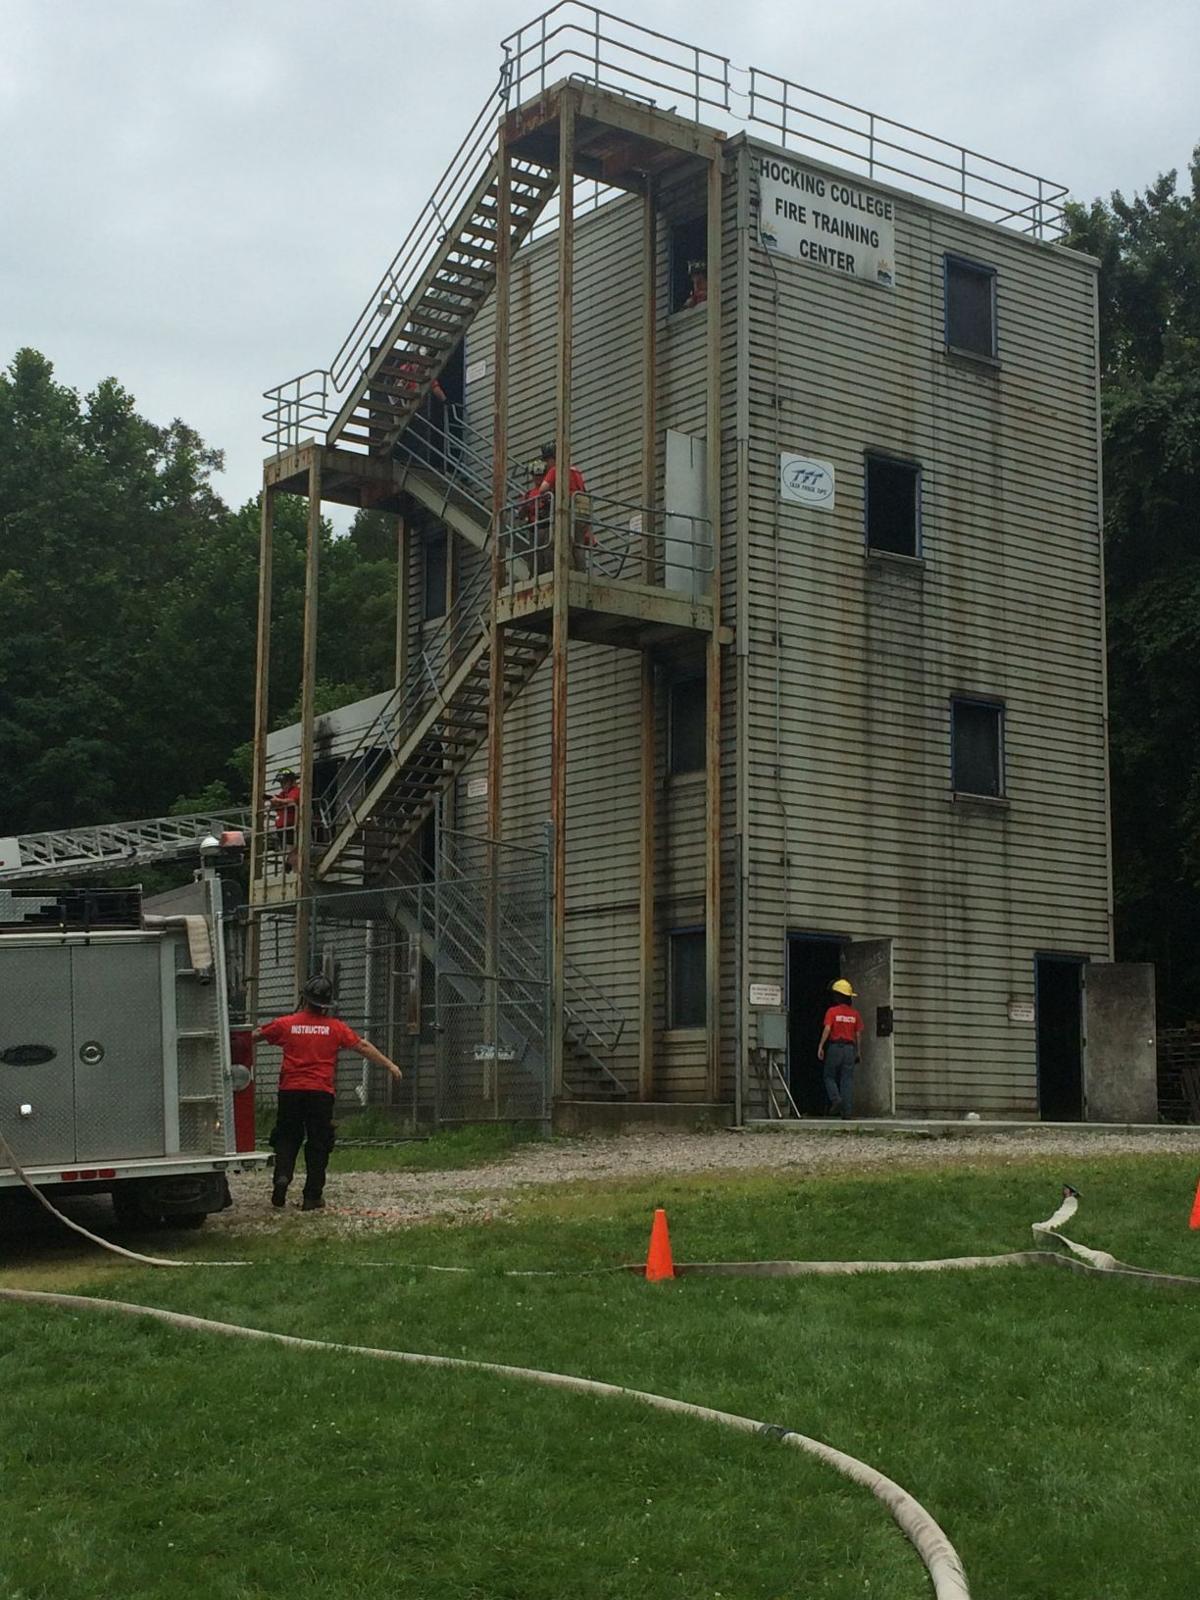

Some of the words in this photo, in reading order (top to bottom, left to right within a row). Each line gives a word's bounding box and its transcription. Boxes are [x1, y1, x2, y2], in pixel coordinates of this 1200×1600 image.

[760, 159, 825, 197] HOCKING
[831, 184, 893, 221] COLLEGE
[775, 197, 806, 224] FIRE
[812, 210, 879, 248] TRAINING
[799, 239, 855, 273] CENTER
[291, 1025, 330, 1036] INSTRUCTOR
